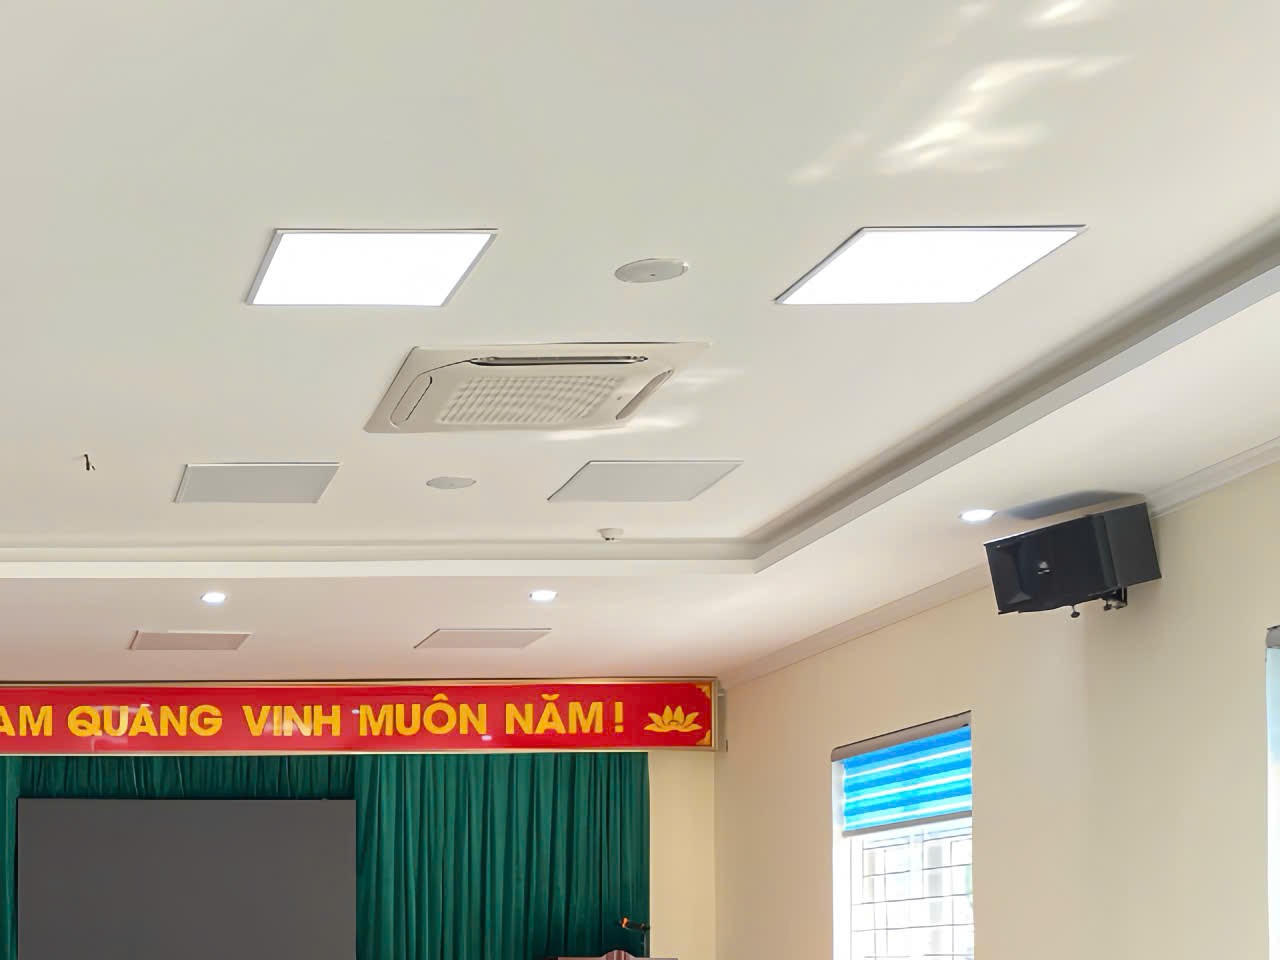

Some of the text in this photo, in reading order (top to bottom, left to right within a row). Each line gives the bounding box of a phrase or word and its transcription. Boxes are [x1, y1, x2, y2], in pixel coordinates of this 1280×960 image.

[67, 704, 223, 738] QUANG
[242, 704, 341, 737] VINH
[358, 693, 487, 737] MUÔN
